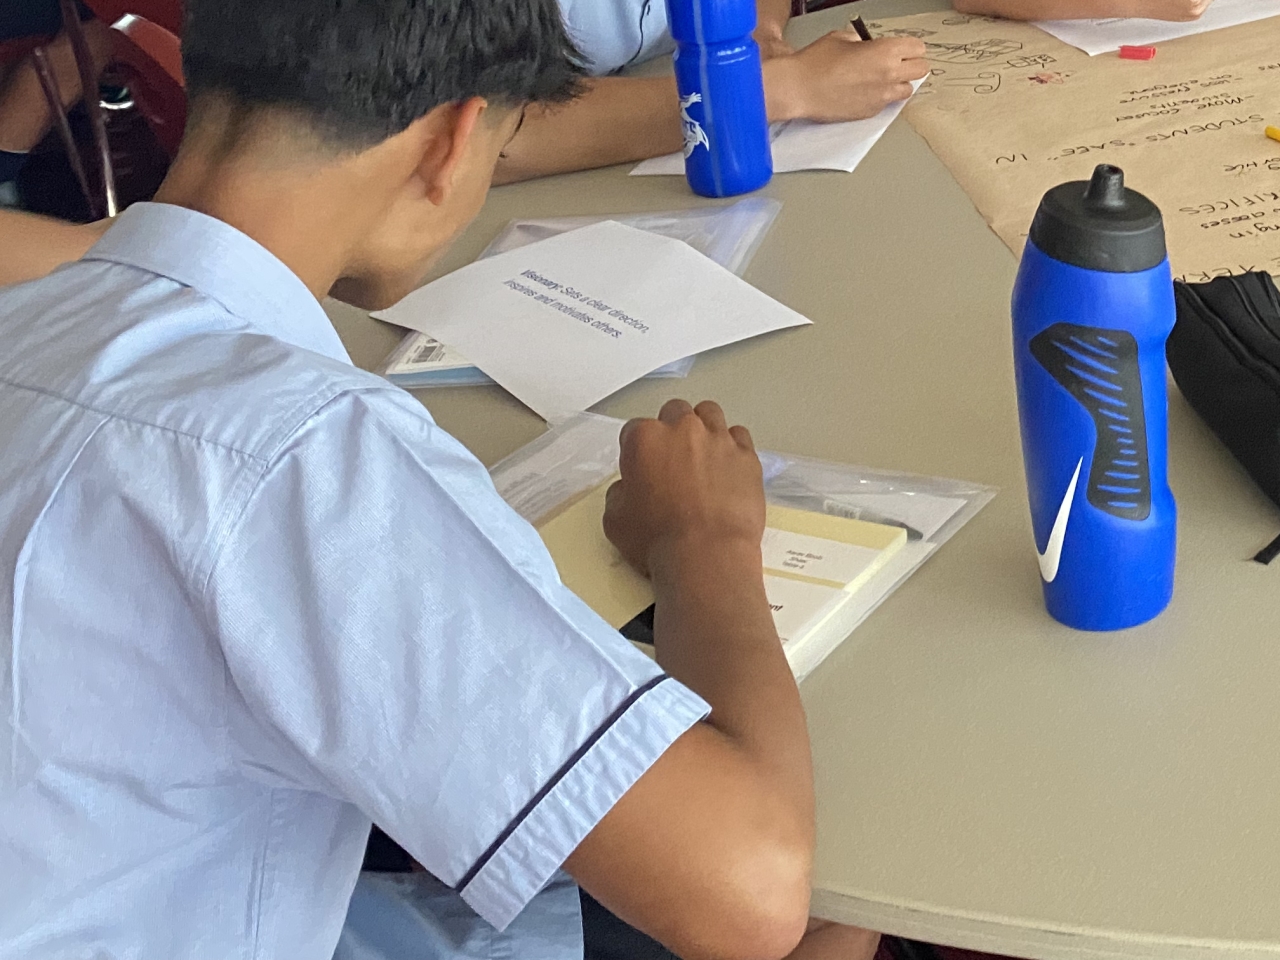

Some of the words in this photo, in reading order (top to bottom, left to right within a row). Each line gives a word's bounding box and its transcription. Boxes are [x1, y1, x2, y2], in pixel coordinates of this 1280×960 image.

[1146, 114, 1264, 142] STUDENTS
[996, 153, 1028, 164] IN
[560, 286, 583, 300] Sets
[586, 300, 612, 312] clear
[550, 300, 593, 324] motivates
[591, 318, 622, 339] others.
